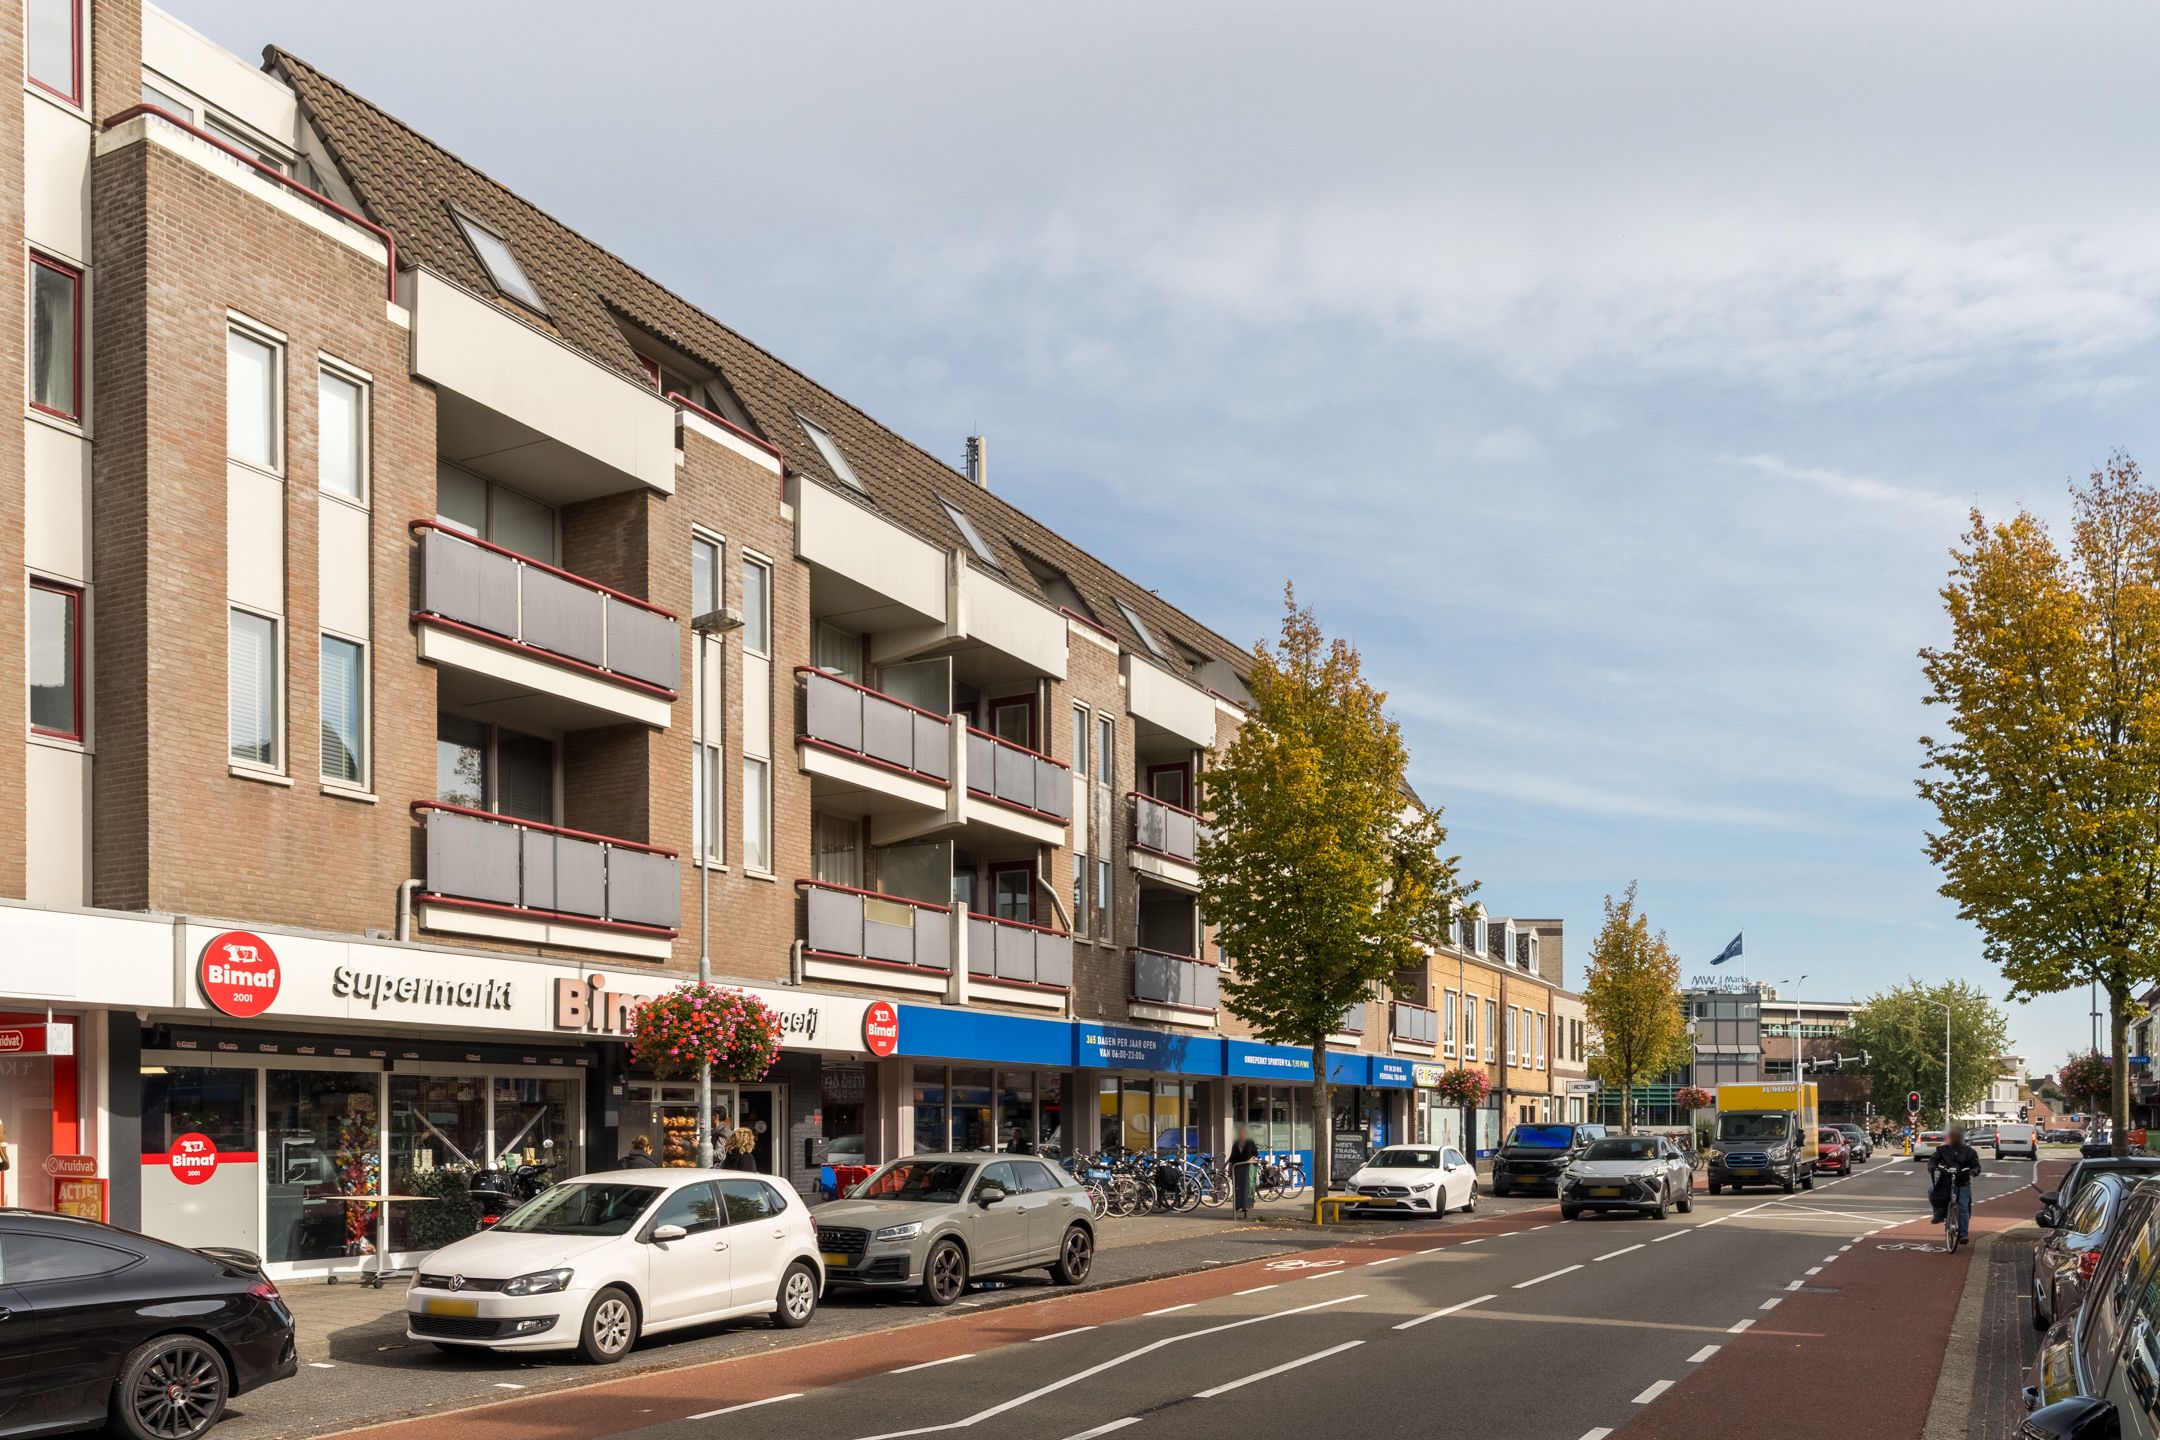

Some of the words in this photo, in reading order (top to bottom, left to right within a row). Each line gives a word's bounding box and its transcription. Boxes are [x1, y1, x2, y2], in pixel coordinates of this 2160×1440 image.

[208, 964, 275, 988] Bimaf
[1724, 975, 1749, 983] Marks
[233, 992, 253, 1003] 2001
[554, 973, 652, 1032] Bim
[779, 1007, 819, 1041] gerij
[868, 1023, 896, 1038] Bimaf
[0, 1034, 20, 1047] idvat
[1086, 1035, 1096, 1044] 365
[1097, 1036, 1116, 1046] DAGEN
[1117, 1038, 1128, 1047] PER
[1129, 1039, 1142, 1049] JAAR
[1142, 1041, 1157, 1050] OPEN
[1099, 1048, 1111, 1058] VAN
[59, 1159, 95, 1172] Kruidvat
[172, 1153, 215, 1167] Bimaf
[58, 1184, 98, 1201] ACTIE!
[80, 1203, 97, 1217] 2+2
